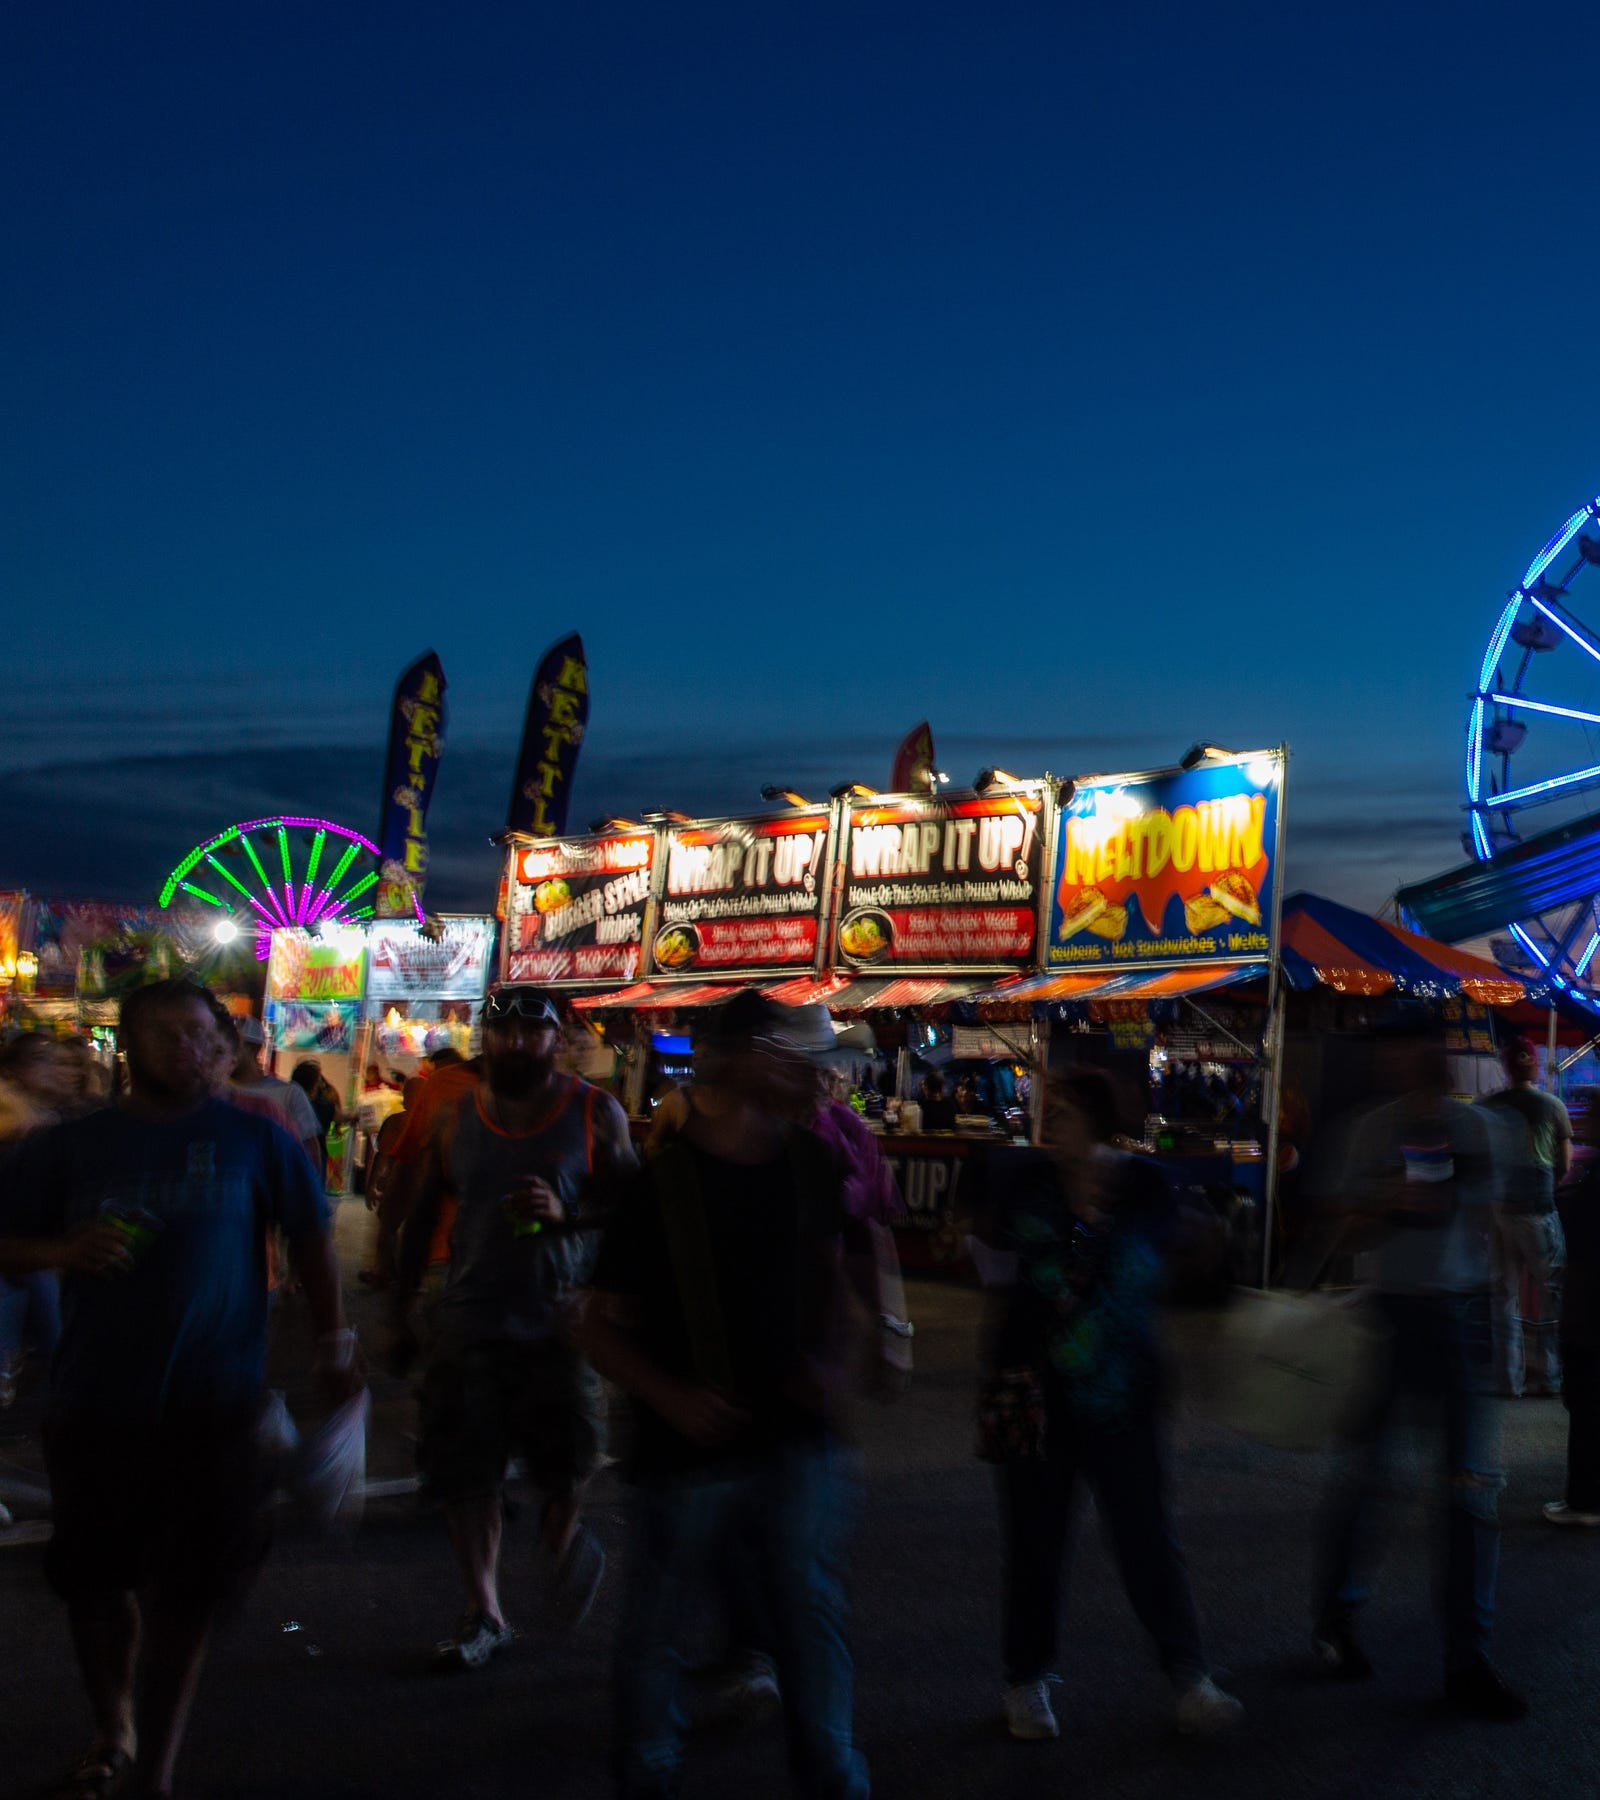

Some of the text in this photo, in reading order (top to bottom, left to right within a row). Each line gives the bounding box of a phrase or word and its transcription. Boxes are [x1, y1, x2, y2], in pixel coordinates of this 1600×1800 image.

[533, 656, 587, 834] KETTL
[668, 842, 744, 895] WRAP
[743, 838, 774, 887] IT
[774, 829, 826, 893] UP!
[852, 811, 1038, 880] WRAP IT UP!
[1064, 794, 1266, 886] MELTDOWN
[604, 868, 650, 914] STYLE
[964, 880, 999, 902] PHILLY
[1000, 878, 1033, 900] WRAP
[1050, 932, 1269, 963] Reubens Hot Sandwiches Melts
